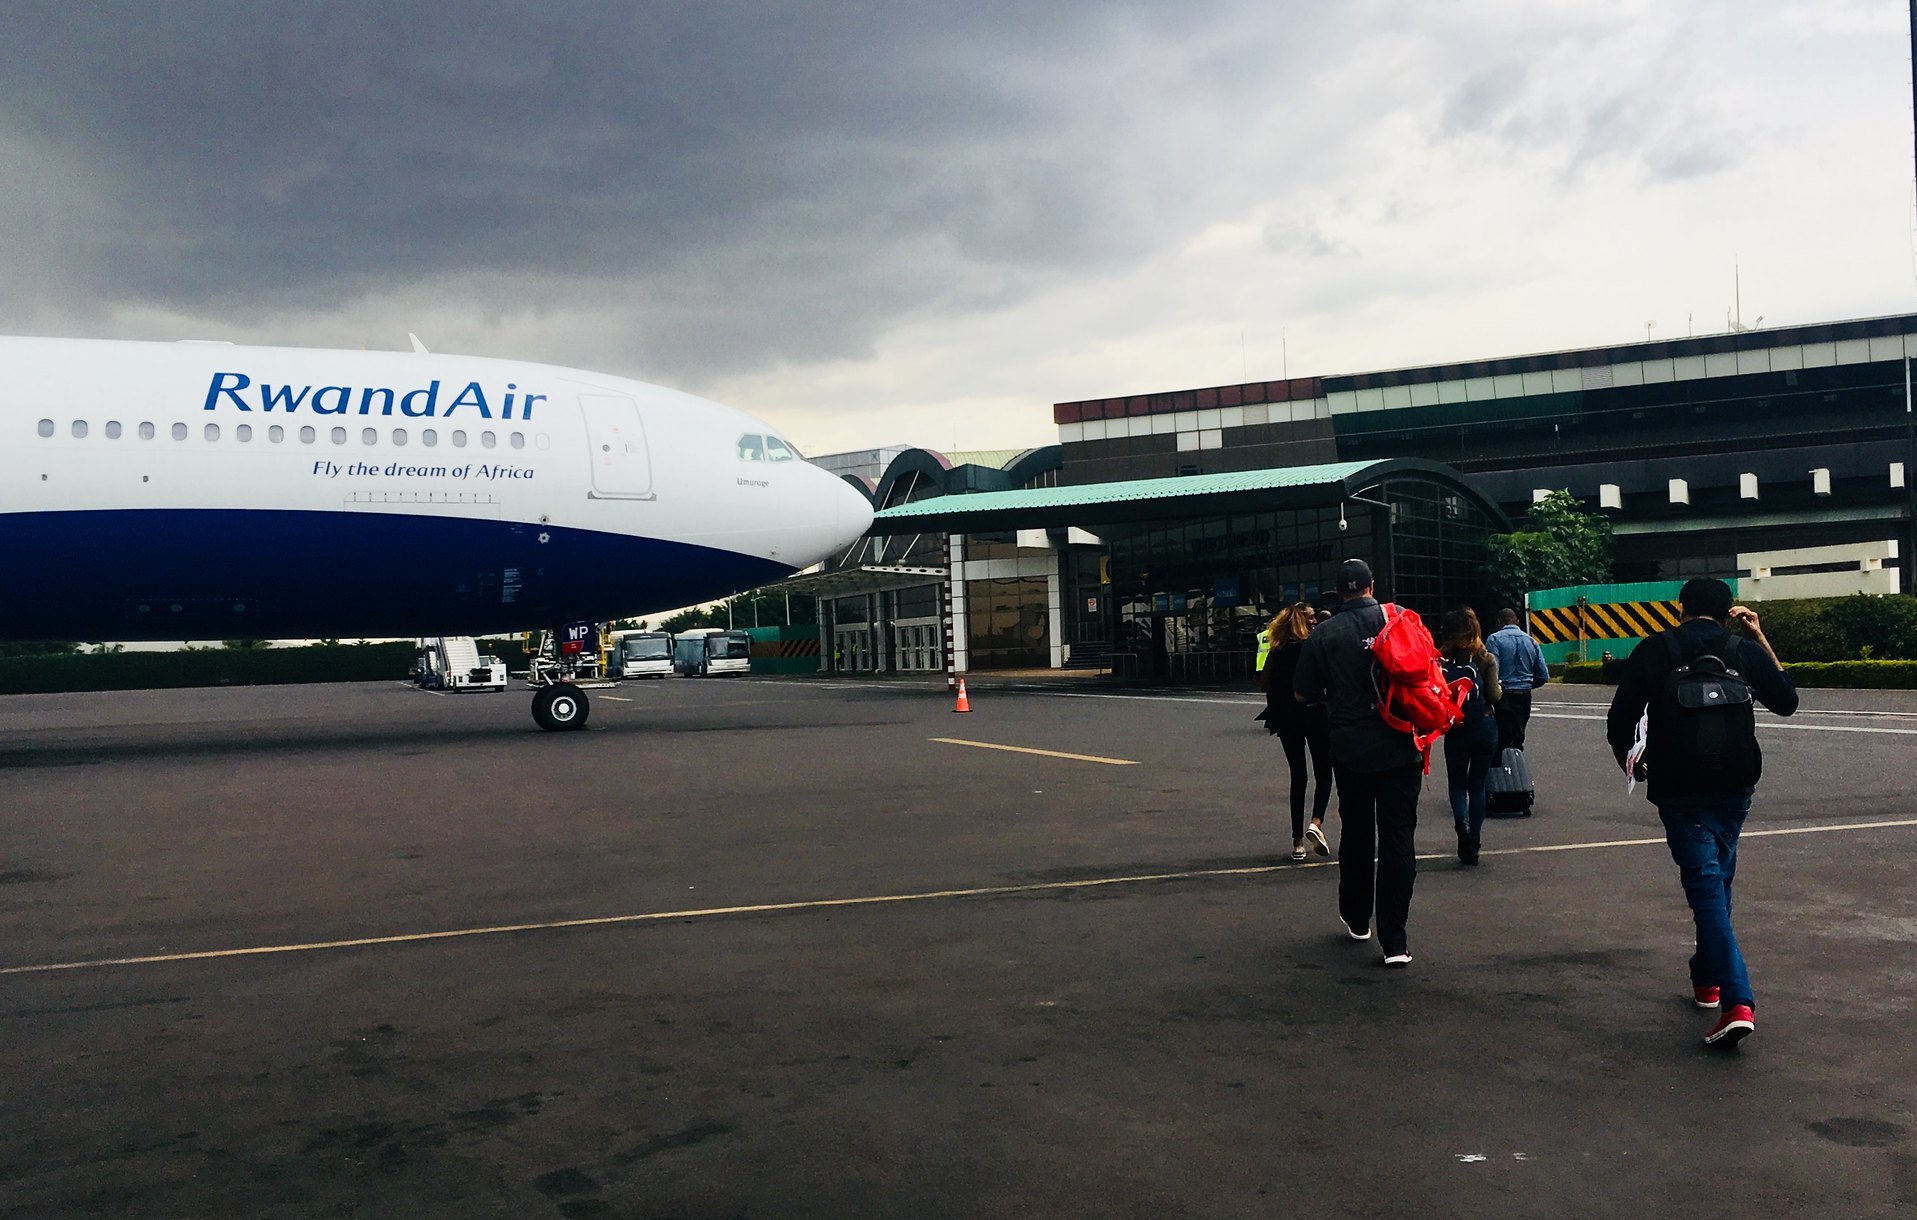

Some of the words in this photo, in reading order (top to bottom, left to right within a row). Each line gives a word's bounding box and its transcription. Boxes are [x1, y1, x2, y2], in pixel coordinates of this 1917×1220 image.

[203, 372, 547, 420] RwandAir
[313, 461, 343, 478] Fly
[348, 461, 379, 476] the
[384, 462, 447, 477] dream
[452, 464, 472, 480] of
[476, 464, 535, 480] Africa
[568, 626, 589, 640] WP
